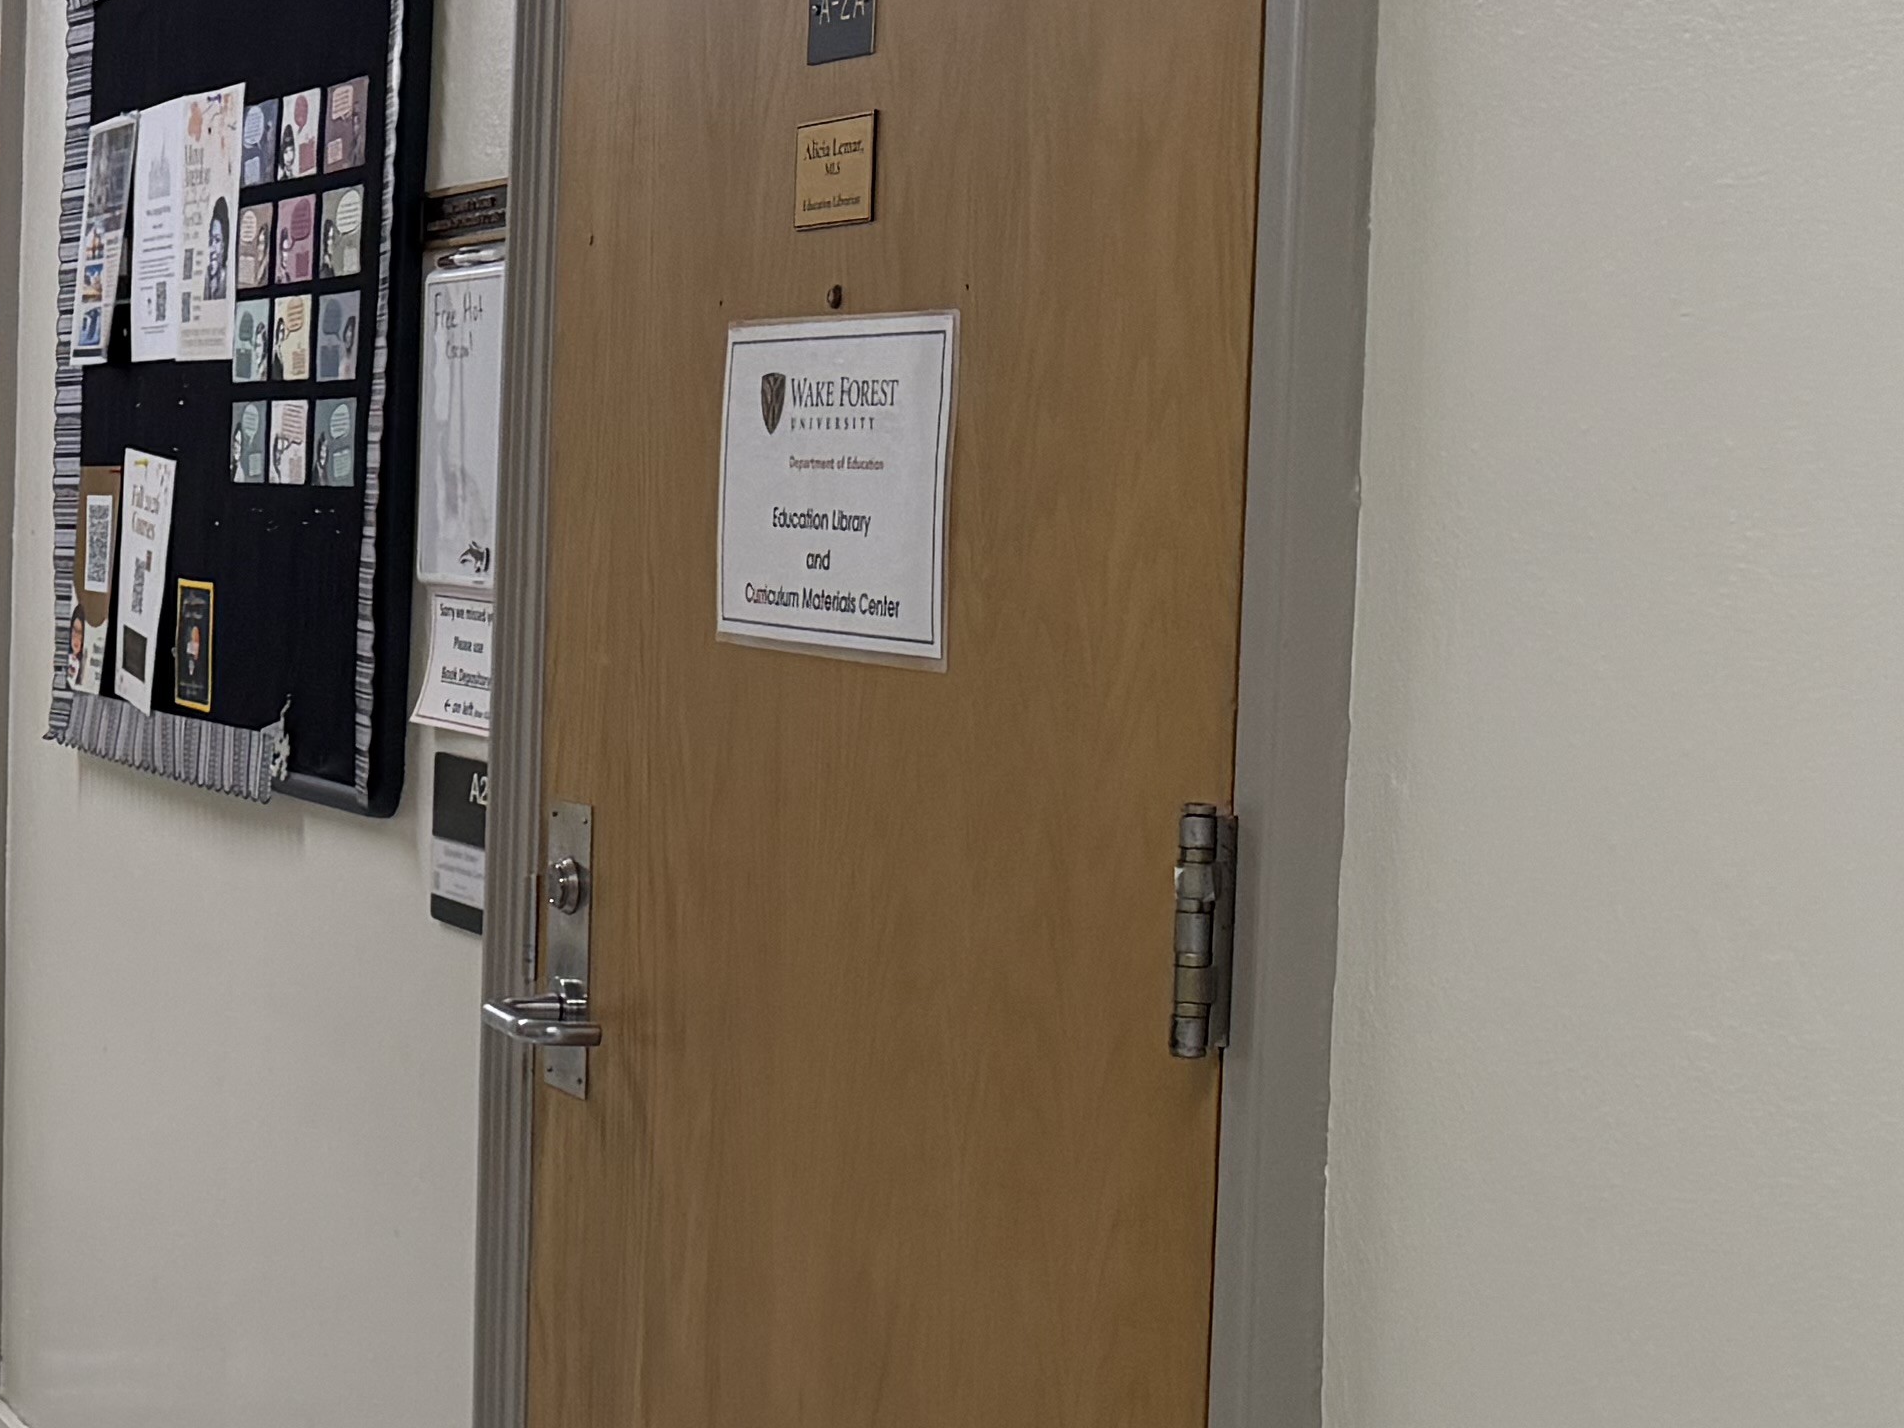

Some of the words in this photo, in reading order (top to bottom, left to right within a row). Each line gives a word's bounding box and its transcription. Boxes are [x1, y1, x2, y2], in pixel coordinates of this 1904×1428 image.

[803, 140, 830, 160] Alicia
[434, 292, 458, 331] Free
[462, 291, 483, 323] Hot
[791, 377, 835, 408] WAKE
[839, 375, 899, 408] FOREST
[790, 416, 876, 432] UNIVERSITY
[789, 455, 835, 472] Department
[837, 455, 845, 470] of
[847, 456, 884, 471] Education
[773, 507, 829, 532] Education
[832, 510, 872, 537] Library
[806, 549, 831, 571] and
[745, 582, 800, 609] Curriculum
[802, 589, 856, 615] Materials
[859, 594, 900, 619] Center
